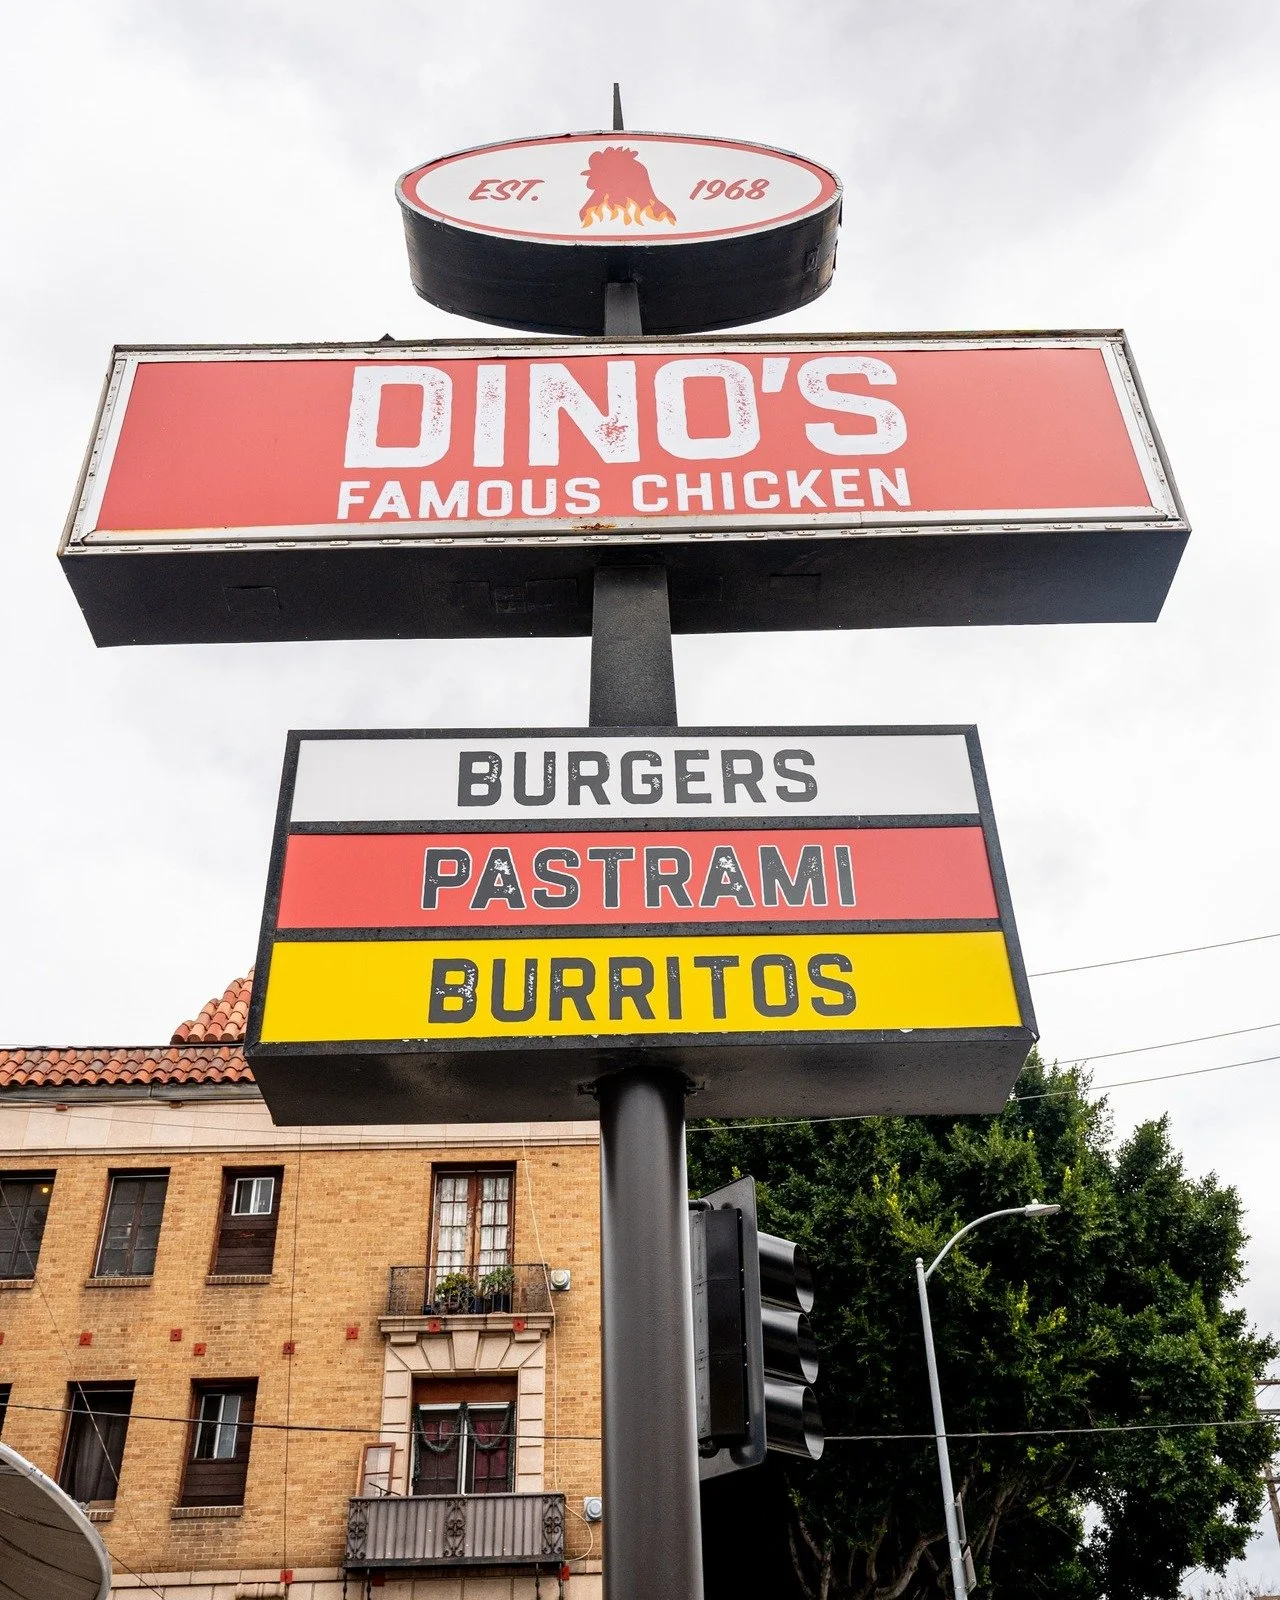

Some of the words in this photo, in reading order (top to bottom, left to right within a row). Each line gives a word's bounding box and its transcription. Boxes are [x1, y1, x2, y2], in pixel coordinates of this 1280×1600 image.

[468, 178, 548, 201] EST.
[688, 178, 770, 201] 1968
[344, 356, 907, 469] DINO'S
[337, 476, 601, 520] FAMOUS
[632, 467, 912, 513] CHICKEN
[457, 749, 818, 807] BURGERS
[421, 844, 856, 911] PASTRAMI
[428, 953, 857, 1024] BURRITOS
